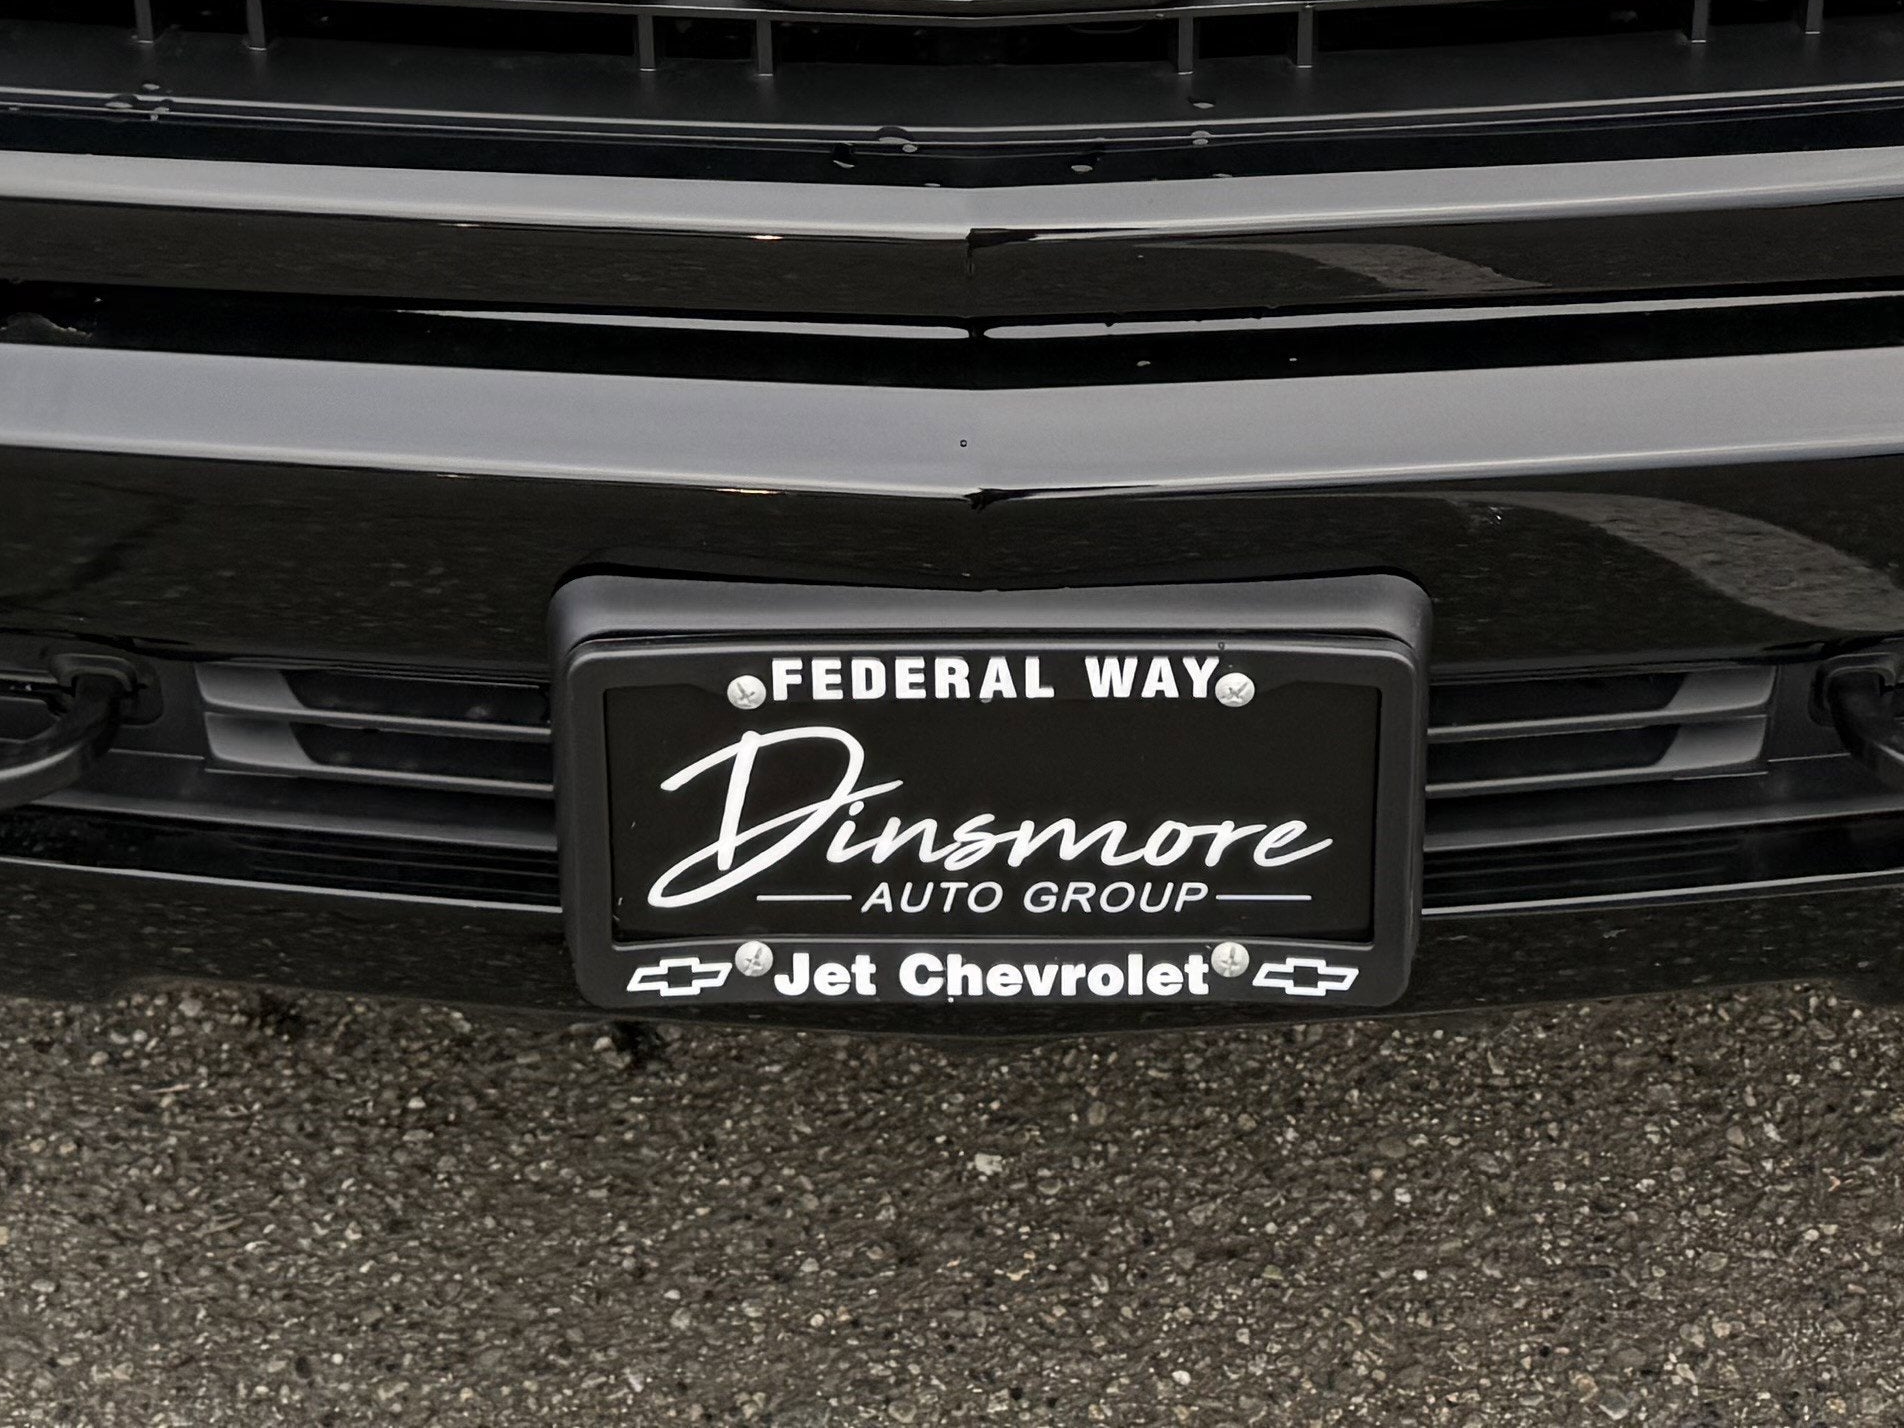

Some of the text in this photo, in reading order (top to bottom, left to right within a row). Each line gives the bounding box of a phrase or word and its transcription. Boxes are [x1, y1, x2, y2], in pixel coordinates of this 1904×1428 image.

[771, 656, 1222, 701] FEDERAL WAY
[647, 726, 1333, 909] Dinsmore
[860, 881, 1209, 914] AUTO GROUP
[773, 952, 1210, 997] Jet Chevrolet
